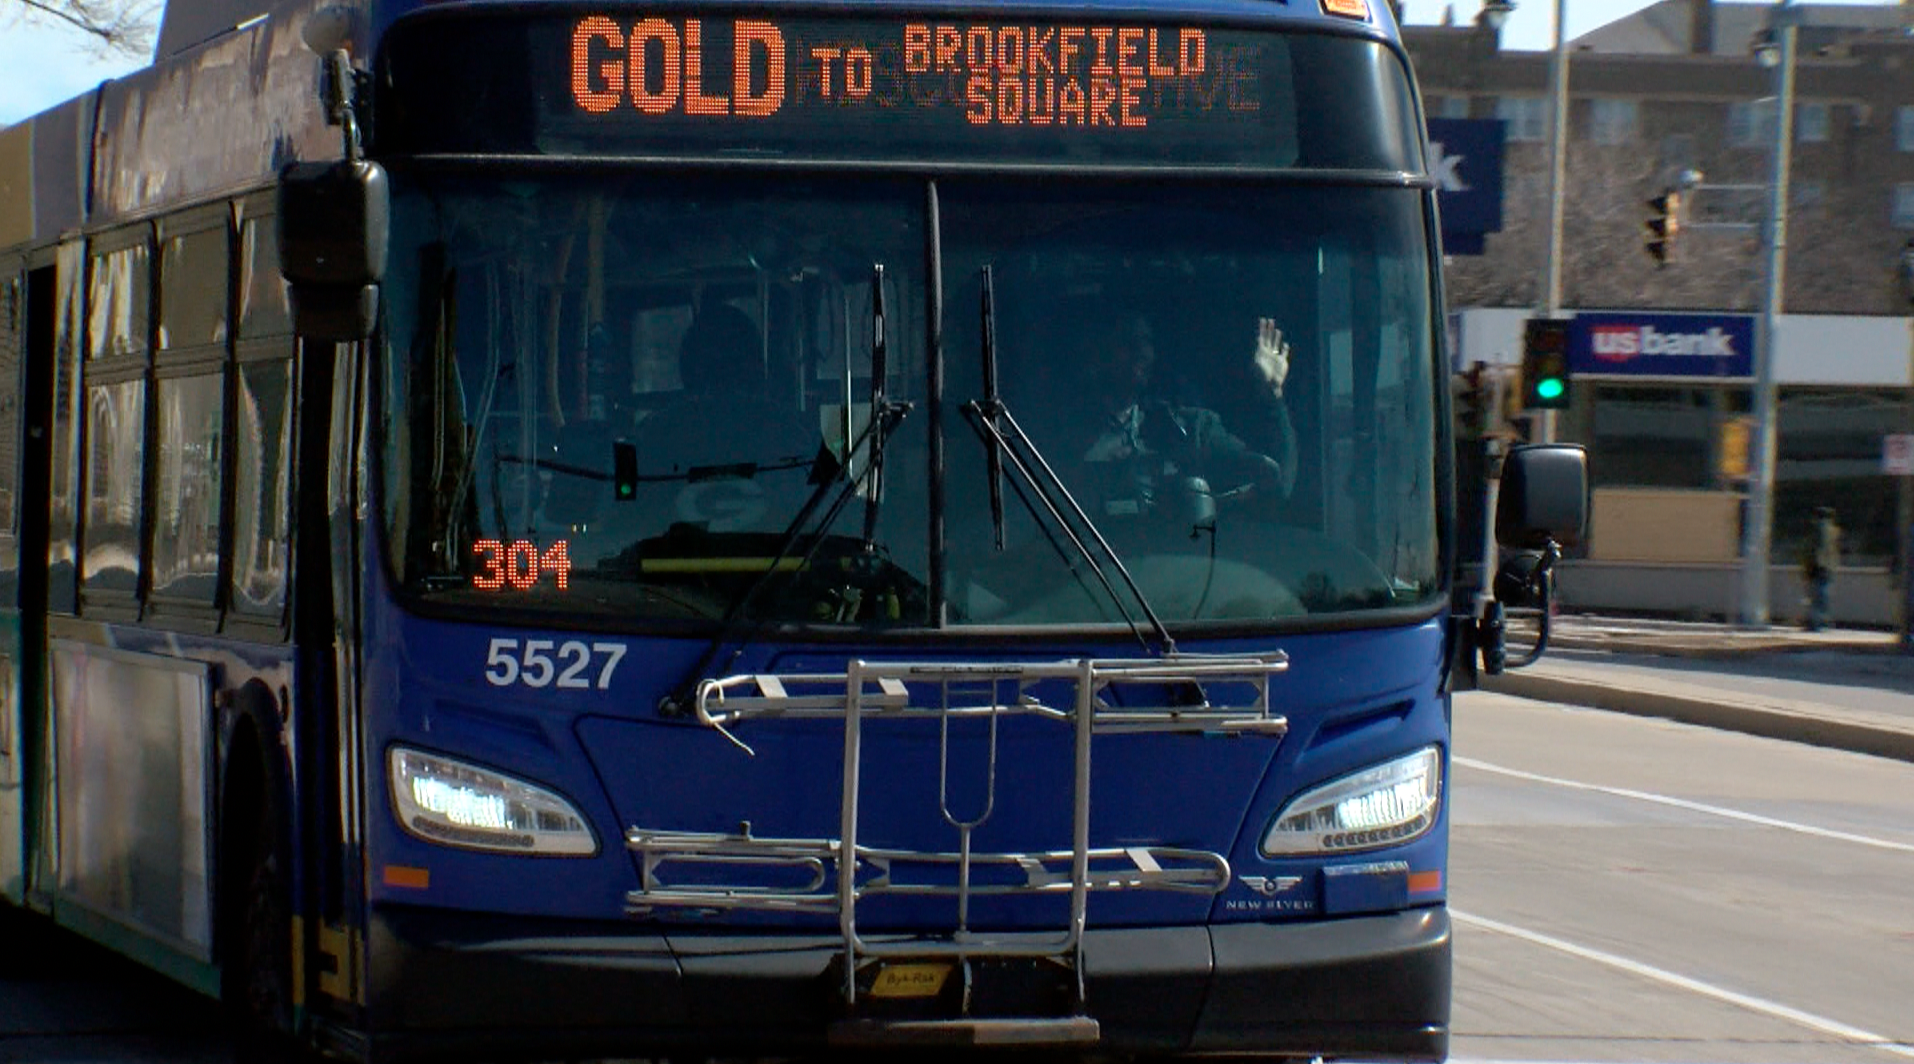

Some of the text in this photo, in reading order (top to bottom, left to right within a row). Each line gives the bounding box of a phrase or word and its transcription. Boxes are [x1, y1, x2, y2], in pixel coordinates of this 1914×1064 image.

[571, 16, 785, 115] GOLD
[811, 47, 872, 96] TO
[903, 23, 1207, 76] BROOKFIELD
[965, 75, 1148, 126] SQUARE
[473, 539, 572, 589] 304
[485, 638, 628, 690] 5527
[1226, 900, 1263, 910] NEW
